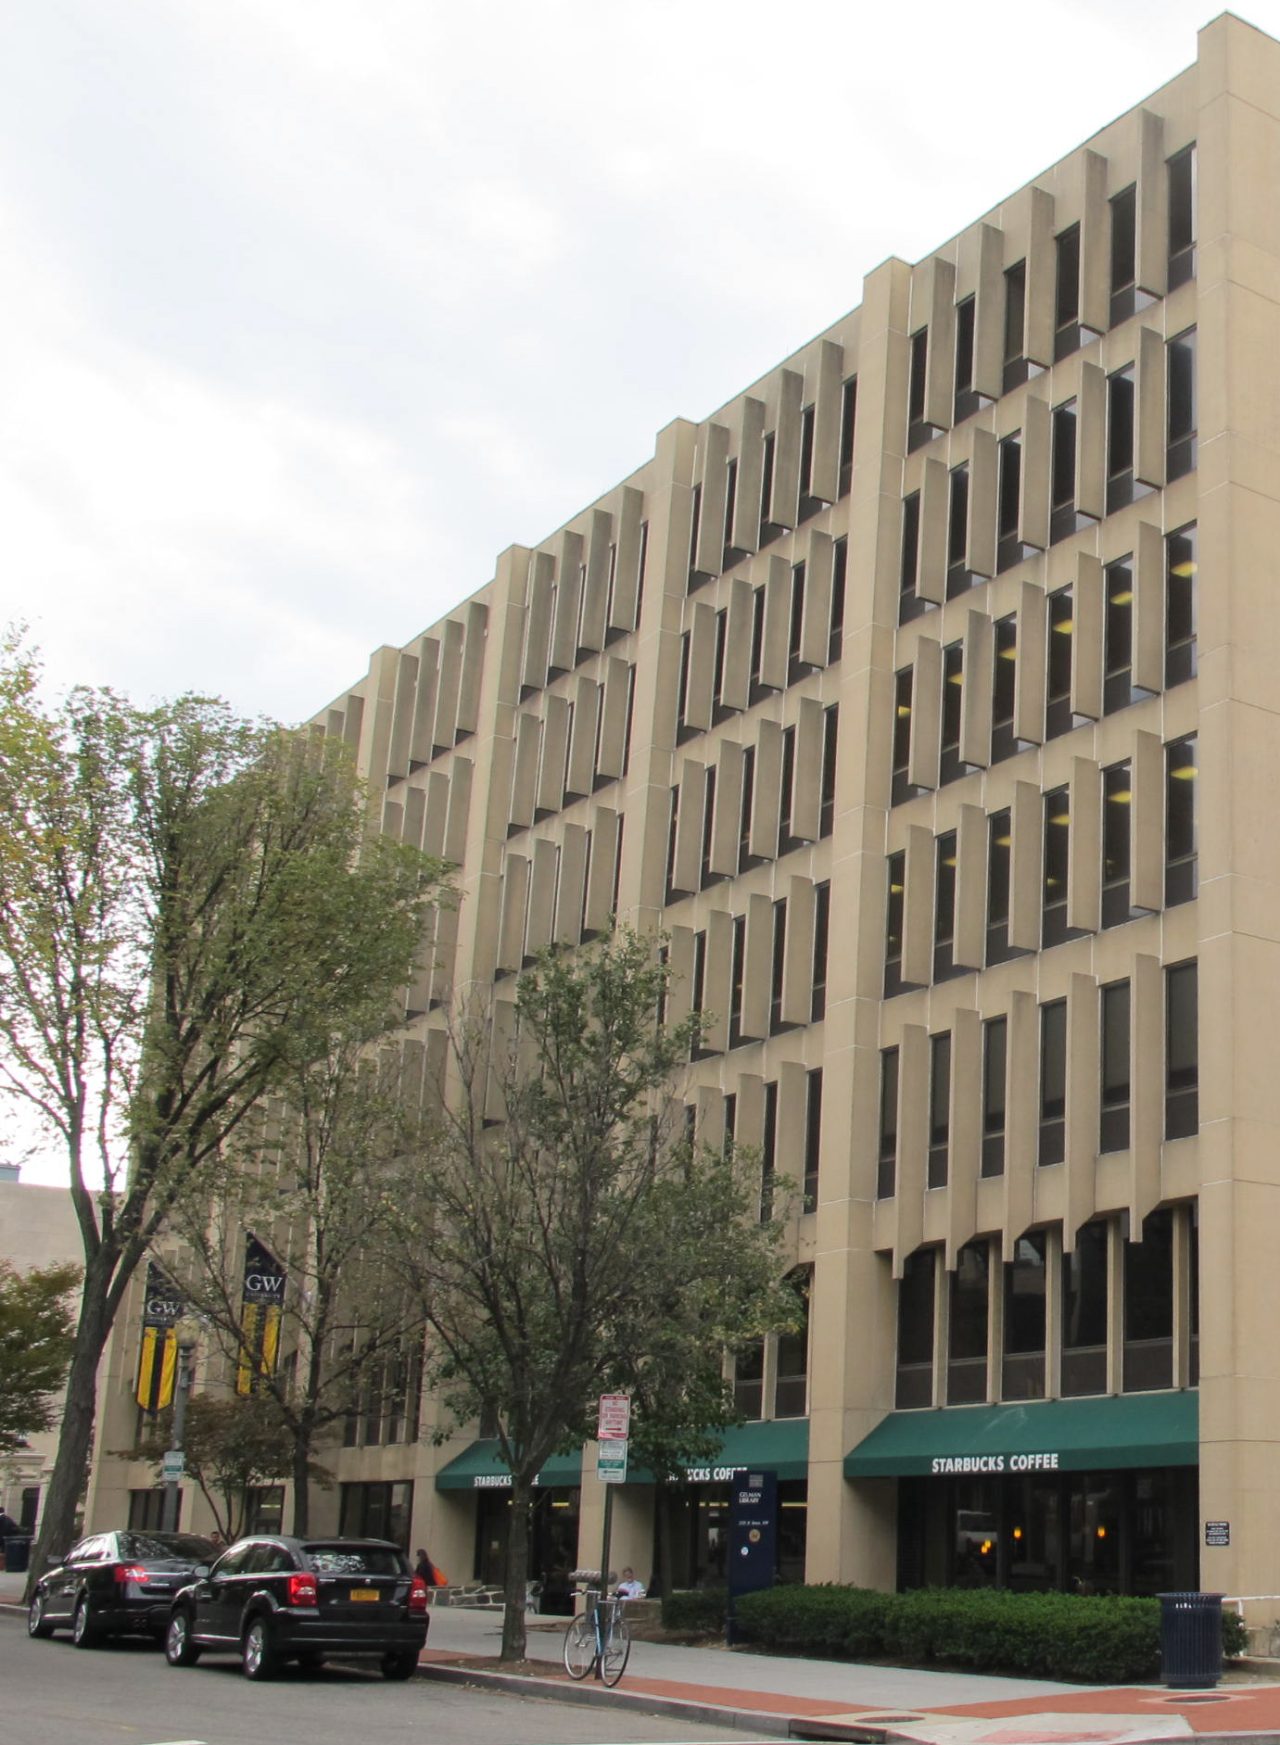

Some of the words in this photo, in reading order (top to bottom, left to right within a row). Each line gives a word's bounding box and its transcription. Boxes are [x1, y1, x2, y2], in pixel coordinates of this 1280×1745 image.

[246, 1274, 283, 1292] GW
[147, 1300, 179, 1316] GW
[932, 1455, 1005, 1473] STARBUCKS
[1009, 1453, 1059, 1471] COFFEE
[474, 1475, 512, 1487] STARBUCKS
